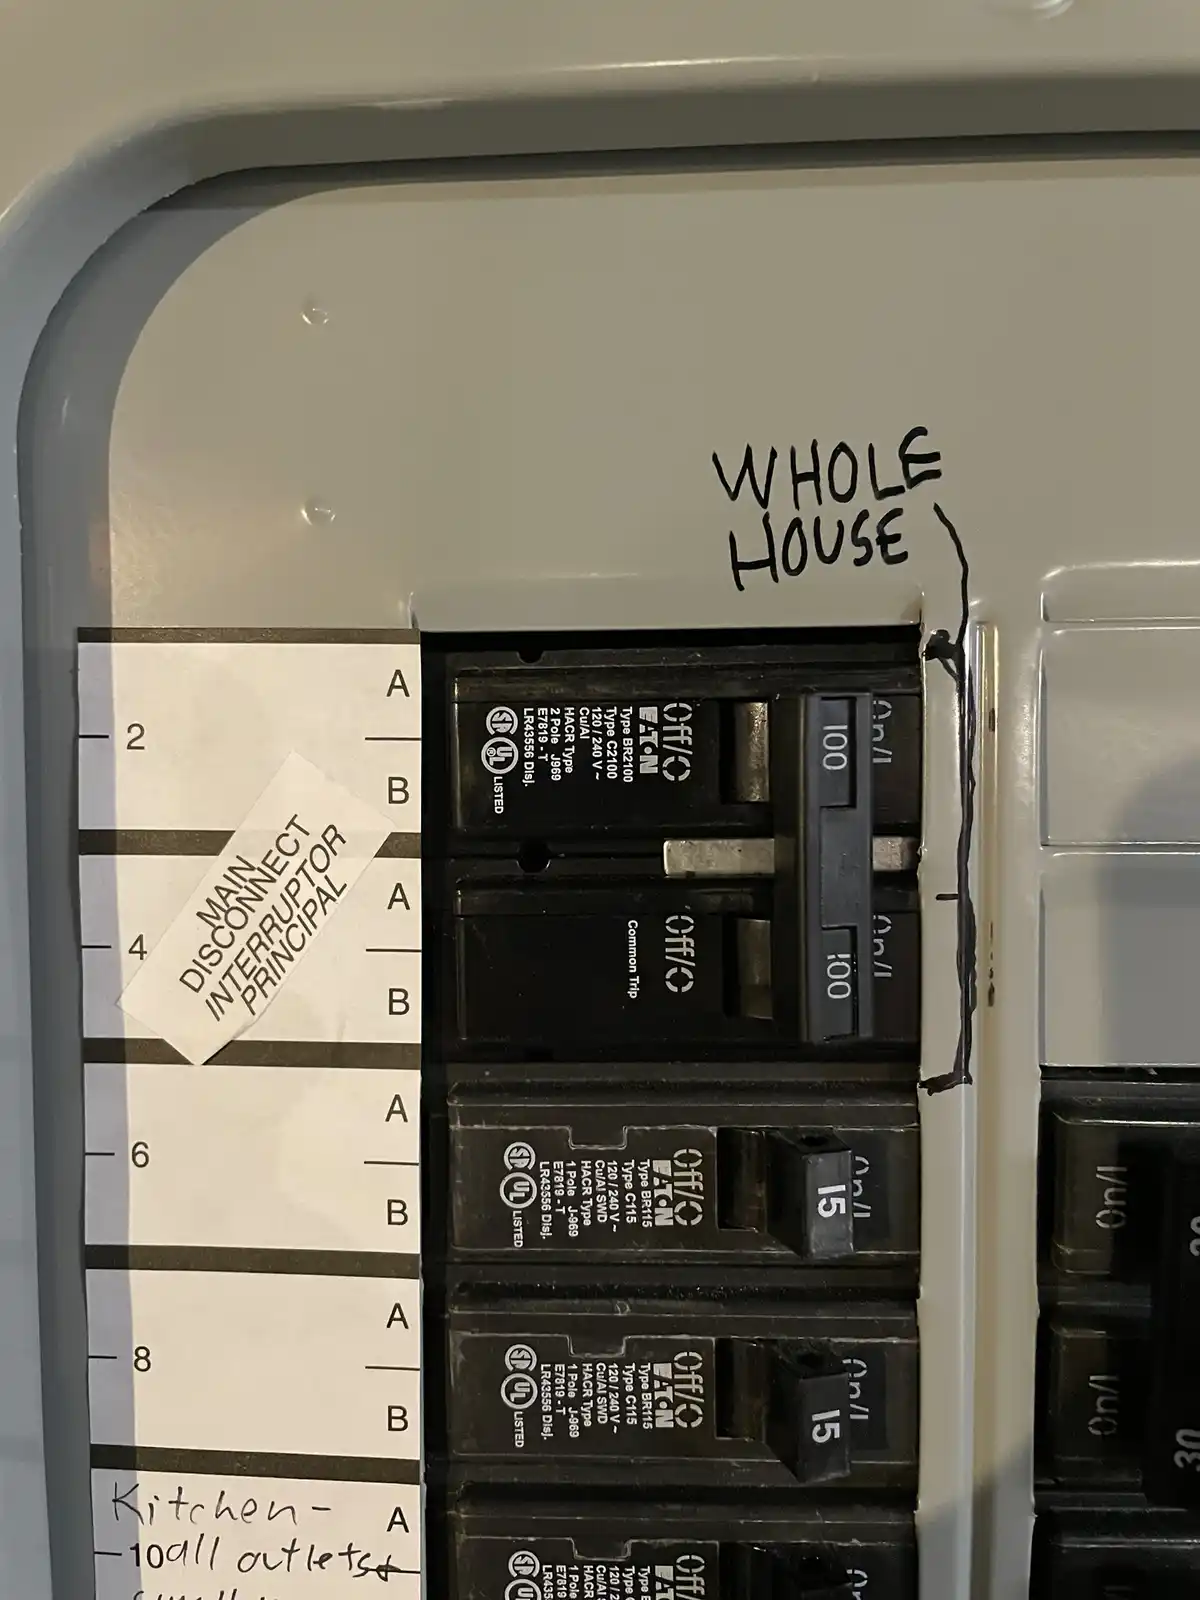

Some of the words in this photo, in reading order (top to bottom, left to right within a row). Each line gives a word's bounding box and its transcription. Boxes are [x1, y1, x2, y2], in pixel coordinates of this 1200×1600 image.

[711, 426, 942, 511] WHOLE
[729, 508, 909, 591] HOUSE
[386, 669, 410, 698] A
[538, 708, 548, 743] E7819
[550, 718, 560, 744] Pole
[564, 707, 574, 742] HACR
[592, 707, 602, 728] 120
[604, 706, 617, 737] Type
[620, 706, 632, 735] Type
[126, 723, 145, 750] 2
[524, 708, 534, 759] LR43556
[592, 738, 602, 758] 240
[823, 724, 848, 770] 100
[550, 754, 562, 781] J969
[562, 746, 574, 774] Type
[592, 761, 602, 769] V
[606, 740, 618, 780] C2100
[622, 738, 634, 783] BR2100
[388, 776, 410, 805] B
[494, 776, 504, 814] LISTED
[179, 814, 310, 994] DISCONNECT
[196, 855, 257, 928] MAIN
[387, 882, 411, 911] A
[205, 824, 347, 1022] INTERRUPTOR
[128, 934, 148, 961] 4
[240, 875, 347, 1016] PRINCIPAL
[627, 920, 638, 972] Common
[627, 975, 640, 998] Trip
[826, 952, 850, 999] 100
[388, 987, 410, 1016] B
[385, 1094, 408, 1123] A
[131, 1141, 149, 1168] 6
[554, 1161, 564, 1196] E7819
[567, 1170, 576, 1196] Pole
[581, 1160, 592, 1196] HACR
[608, 1160, 618, 1182] 120
[622, 1160, 634, 1190] Type
[638, 1159, 650, 1188] Type
[540, 1162, 552, 1212] LR43556
[608, 1188, 619, 1211] 240
[818, 1184, 846, 1218] 15
[387, 1199, 409, 1226] B
[568, 1206, 578, 1237] J-969
[580, 1198, 592, 1226] Type
[597, 1194, 608, 1223] SWD
[609, 1213, 620, 1222] V
[625, 1192, 636, 1224] C115
[640, 1190, 652, 1228] BR115
[513, 1210, 524, 1248] LISTED
[386, 1303, 409, 1330] A
[133, 1346, 151, 1373] 8
[608, 1363, 618, 1383] 120
[540, 1364, 552, 1412] LR43556
[554, 1364, 565, 1398] E7819
[568, 1373, 578, 1398] Pole
[582, 1364, 592, 1397] HACR
[622, 1363, 635, 1392] Type
[638, 1362, 650, 1390] Type
[581, 1400, 593, 1426] Type
[597, 1397, 608, 1424] SWD
[609, 1392, 620, 1412] 240
[626, 1395, 638, 1425] C115
[641, 1392, 652, 1430] BR115
[387, 1406, 409, 1432] B
[514, 1412, 524, 1448] LISTED
[568, 1407, 579, 1438] J-969
[610, 1414, 620, 1423] V
[812, 1410, 840, 1443] 15
[1174, 1429, 1200, 1472] 30
[386, 1506, 410, 1534] A
[129, 1542, 164, 1570] 10
[542, 1565, 553, 1600] LR435
[556, 1565, 566, 1598] E7819
[569, 1573, 580, 1598] Pole
[584, 1565, 594, 1598] HACR
[610, 1566, 620, 1585] 120
[622, 1566, 635, 1594] Type
[638, 1565, 650, 1592] Type
[654, 1565, 674, 1600] EAT
[676, 1554, 705, 1600] Off/
